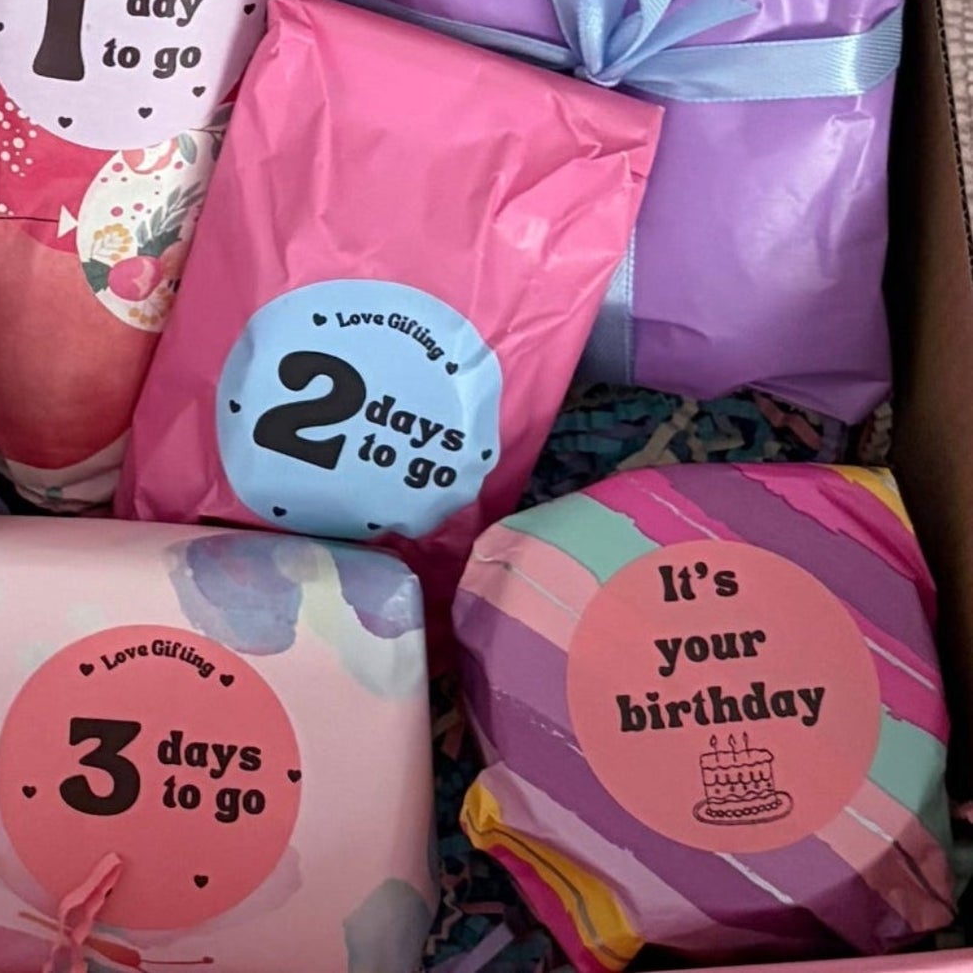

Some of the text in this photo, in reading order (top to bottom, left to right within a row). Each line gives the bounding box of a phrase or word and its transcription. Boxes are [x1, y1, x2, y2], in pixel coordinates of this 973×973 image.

[103, 38, 201, 79] to go
[336, 313, 444, 361] Love Gifting
[253, 350, 367, 470] 2
[365, 395, 466, 452] days
[358, 434, 456, 489] to go
[101, 640, 215, 678] Love Gifting
[655, 630, 766, 677] your
[616, 682, 825, 732] birthday
[59, 718, 141, 816] 3
[158, 731, 261, 779] days
[163, 776, 265, 823] to go
